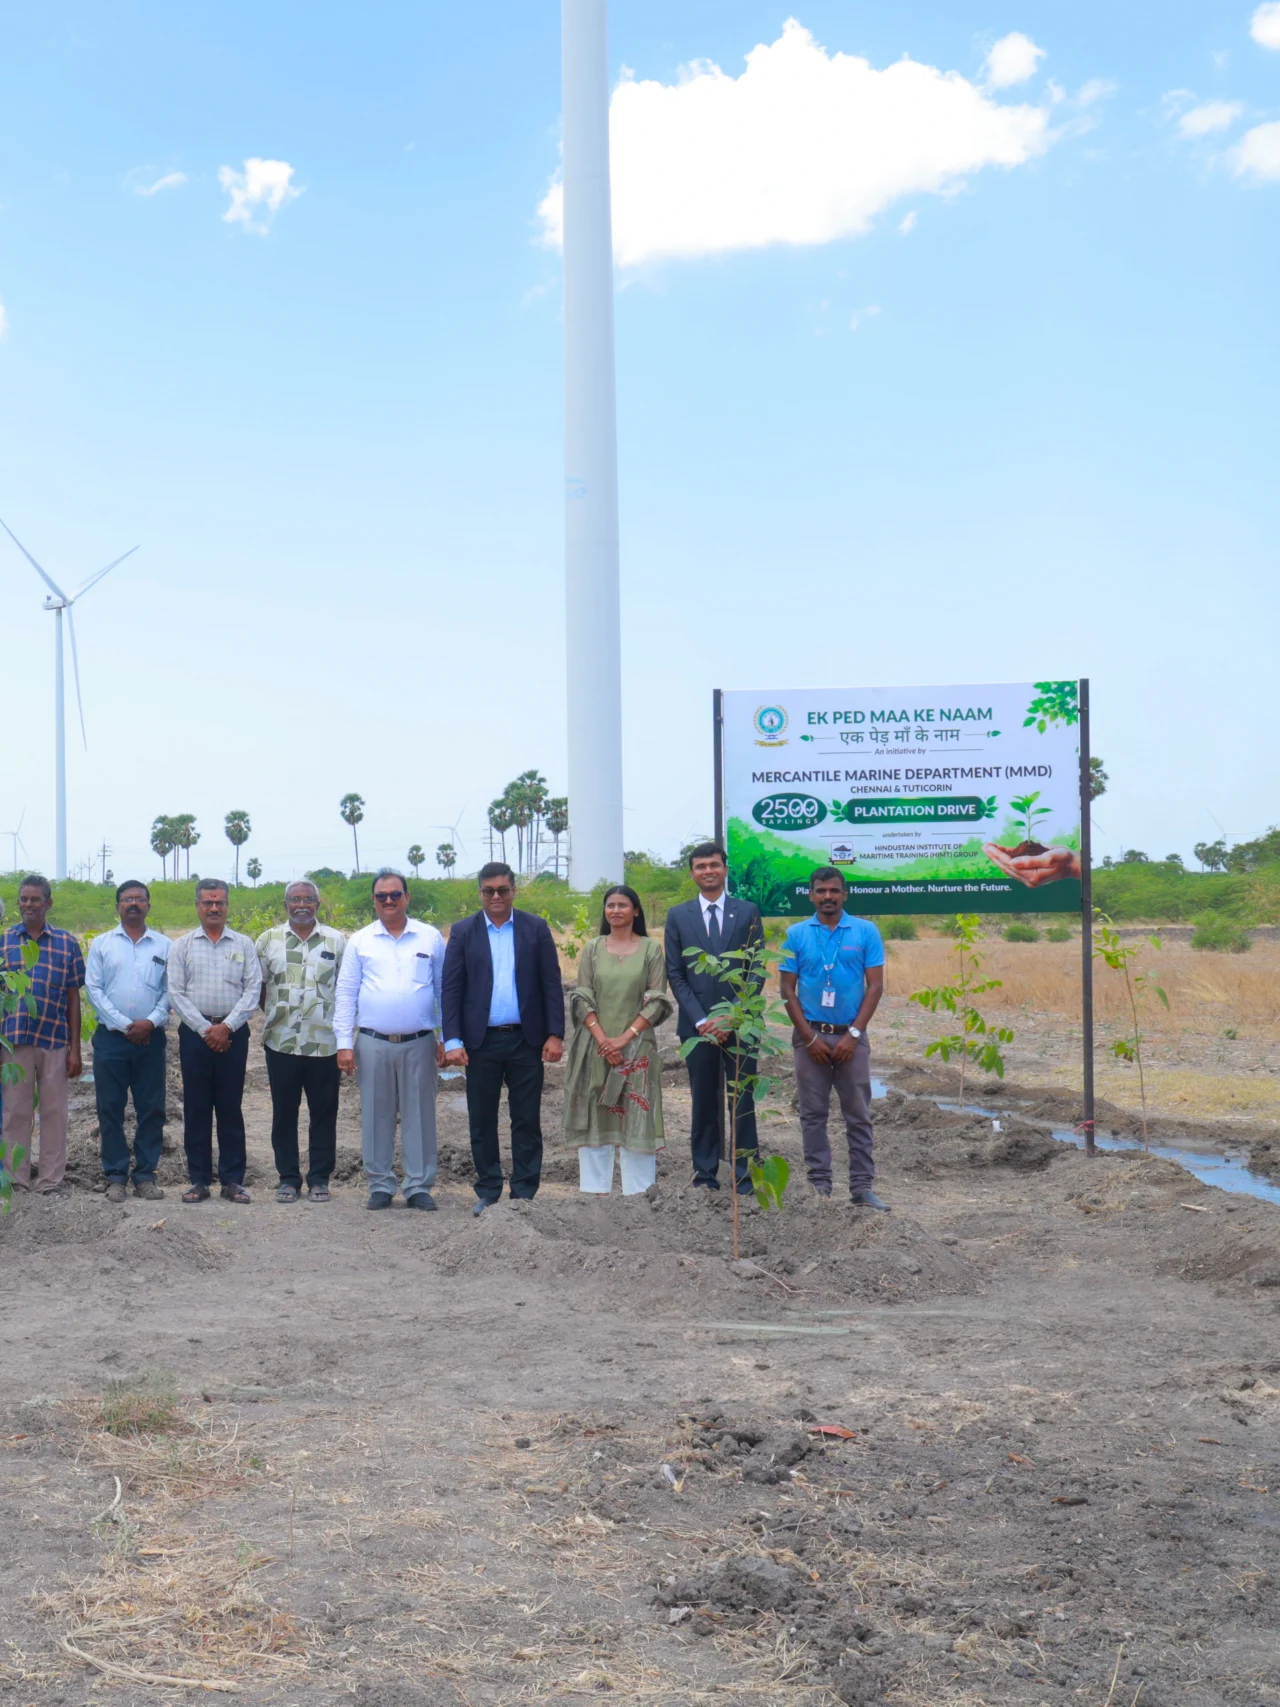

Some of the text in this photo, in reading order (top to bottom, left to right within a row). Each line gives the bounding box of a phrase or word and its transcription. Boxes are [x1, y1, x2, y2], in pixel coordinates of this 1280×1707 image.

[807, 708, 993, 725] EK PED MAA KE NAAM
[840, 726, 960, 746] एक पेड़ माँ के नाम
[918, 748, 926, 756] by
[752, 765, 1052, 784] MERCANTILE MARINE DEPARTMENT (MMD)
[851, 784, 952, 794] CHENNAI & TUTICORIN
[761, 799, 818, 818] 2500
[855, 804, 976, 817] PLANTATION DRIVE
[914, 831, 922, 839] by
[917, 843, 952, 851] INSTITUTE
[897, 851, 929, 859] TRAINING
[930, 851, 952, 859] (HIMT)
[796, 886, 810, 895] Pla
[850, 885, 882, 894] Honour
[892, 884, 926, 893] Mother.
[928, 884, 962, 892] Nurture
[964, 884, 978, 892] the
[980, 884, 1012, 892] Future.
